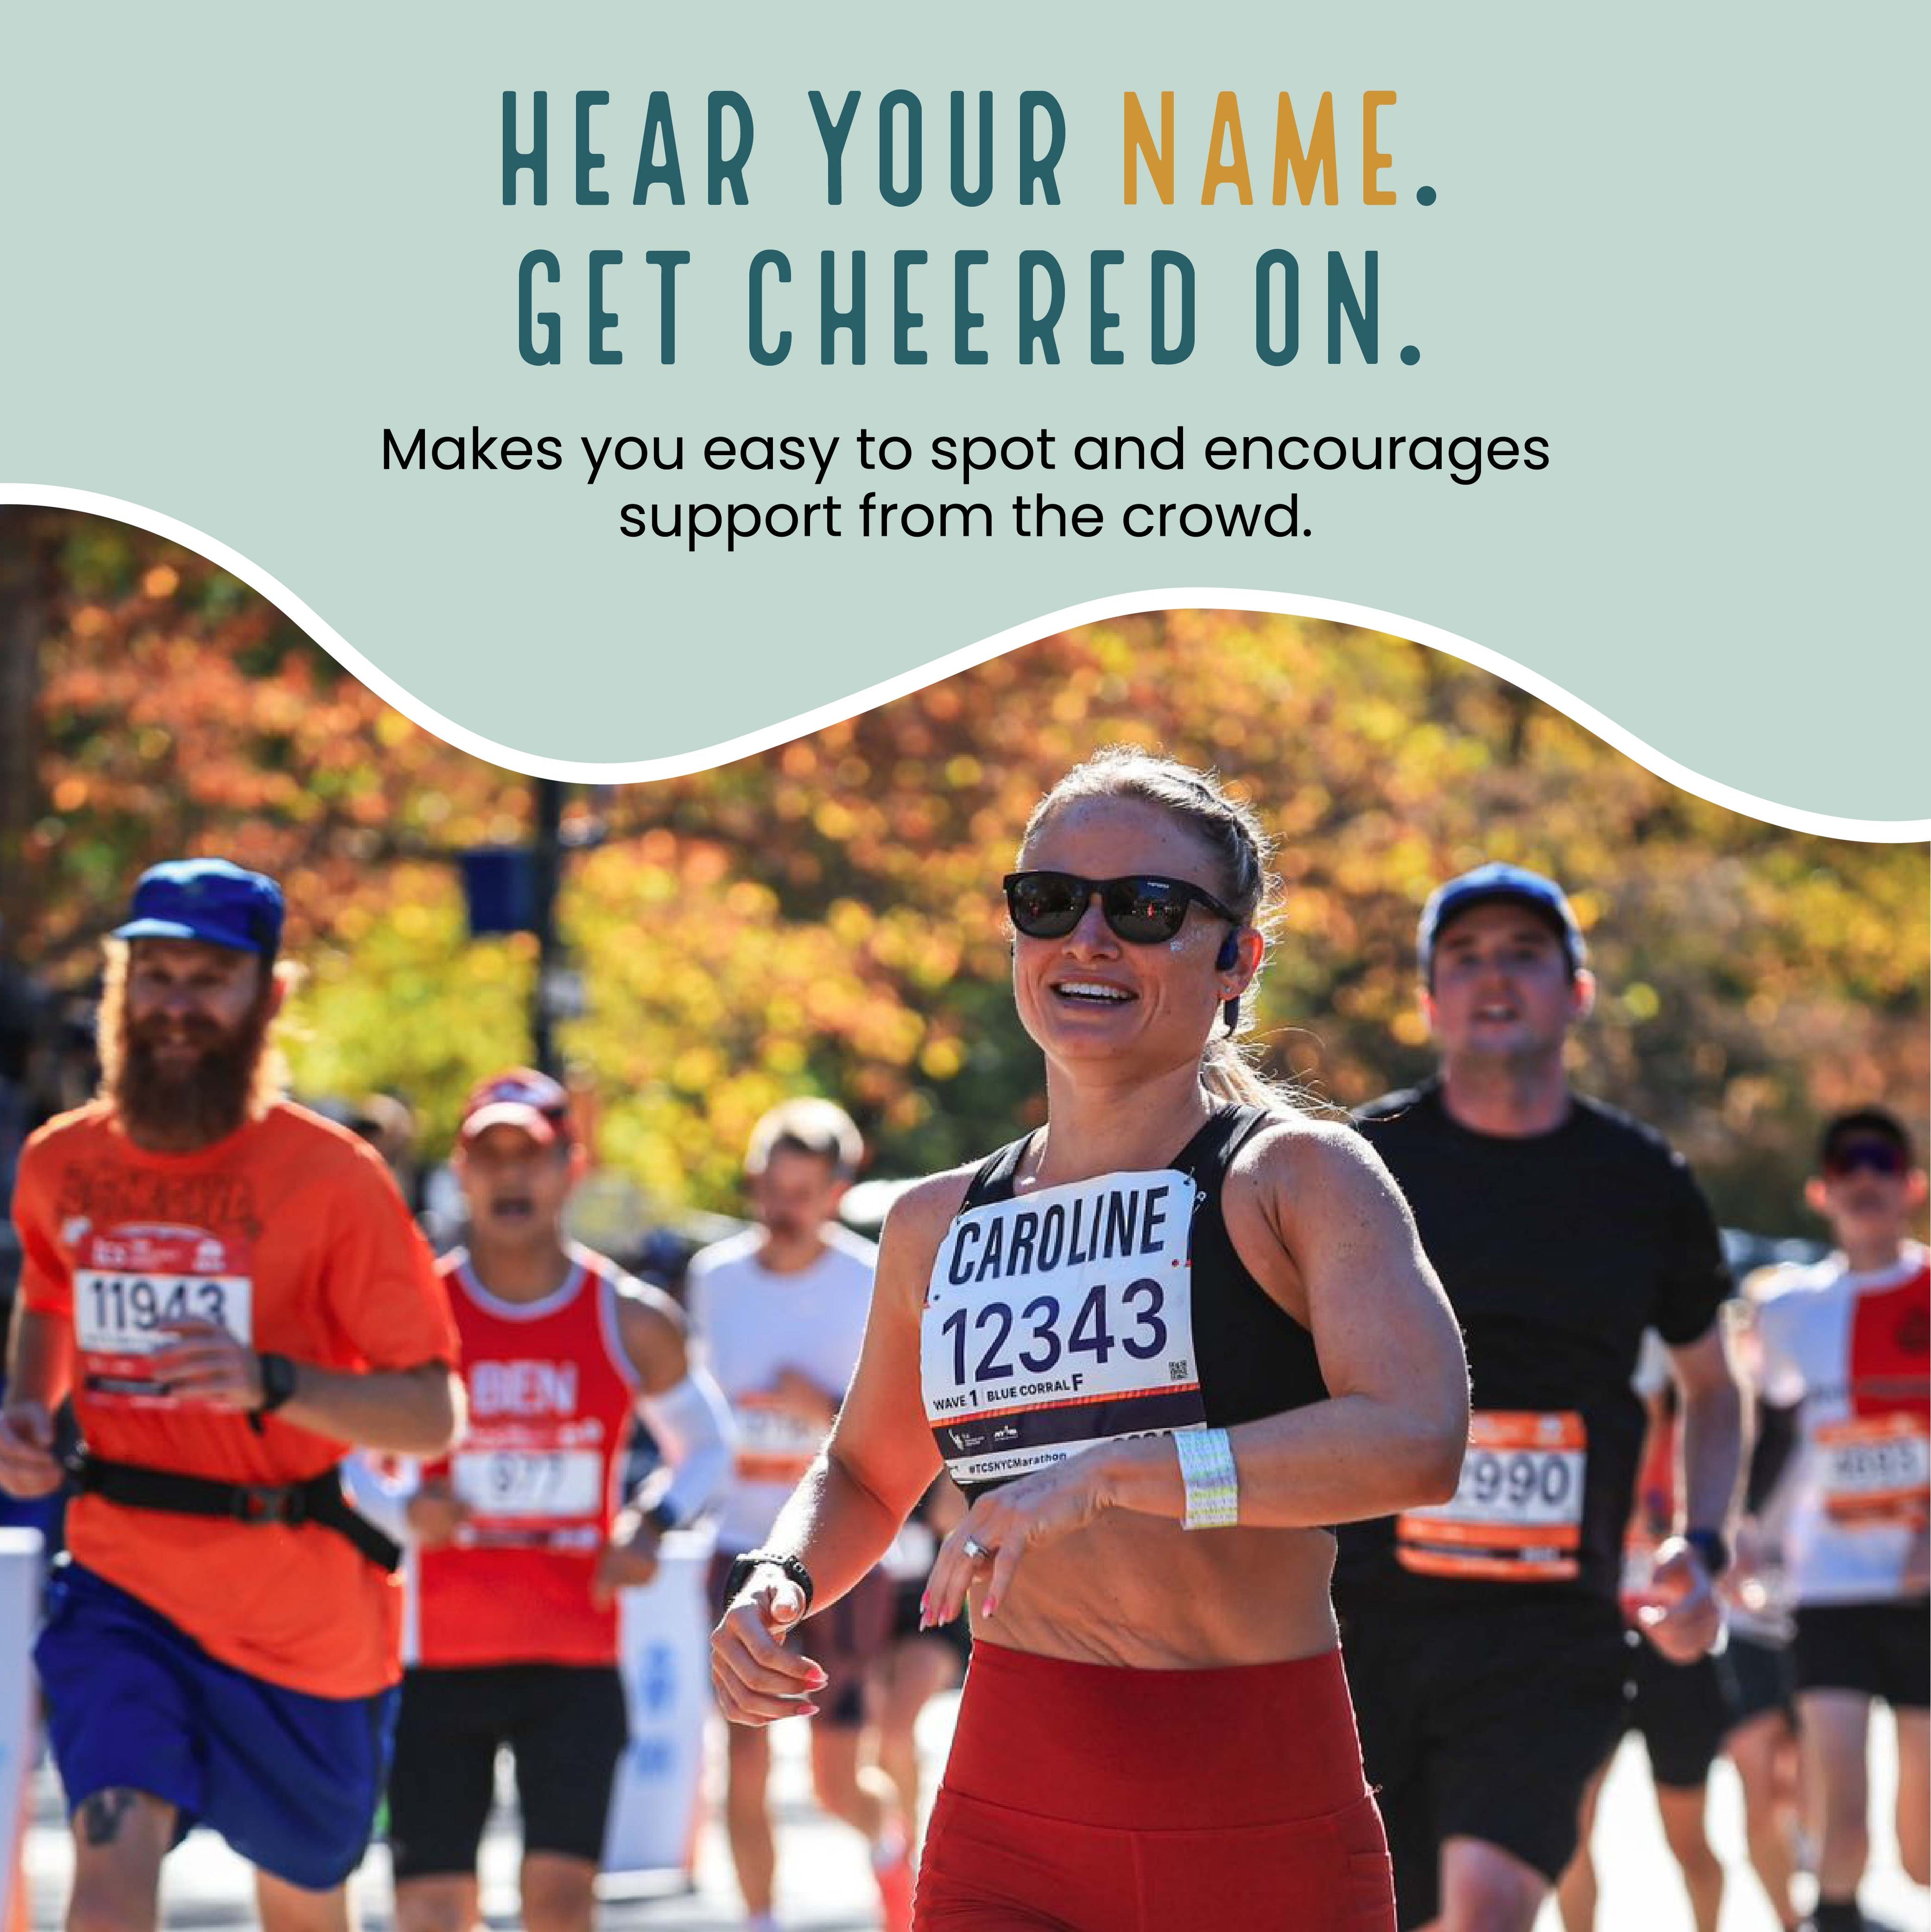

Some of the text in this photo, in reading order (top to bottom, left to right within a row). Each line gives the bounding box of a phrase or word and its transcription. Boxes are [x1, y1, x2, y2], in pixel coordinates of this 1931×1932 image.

[948, 1186, 1169, 1285] CAROLINE
[941, 1278, 1167, 1385] 12343
[933, 1373, 1083, 1410] WAVE 1 BLUE CORRAL F
[1464, 1453, 1570, 1505] 990
